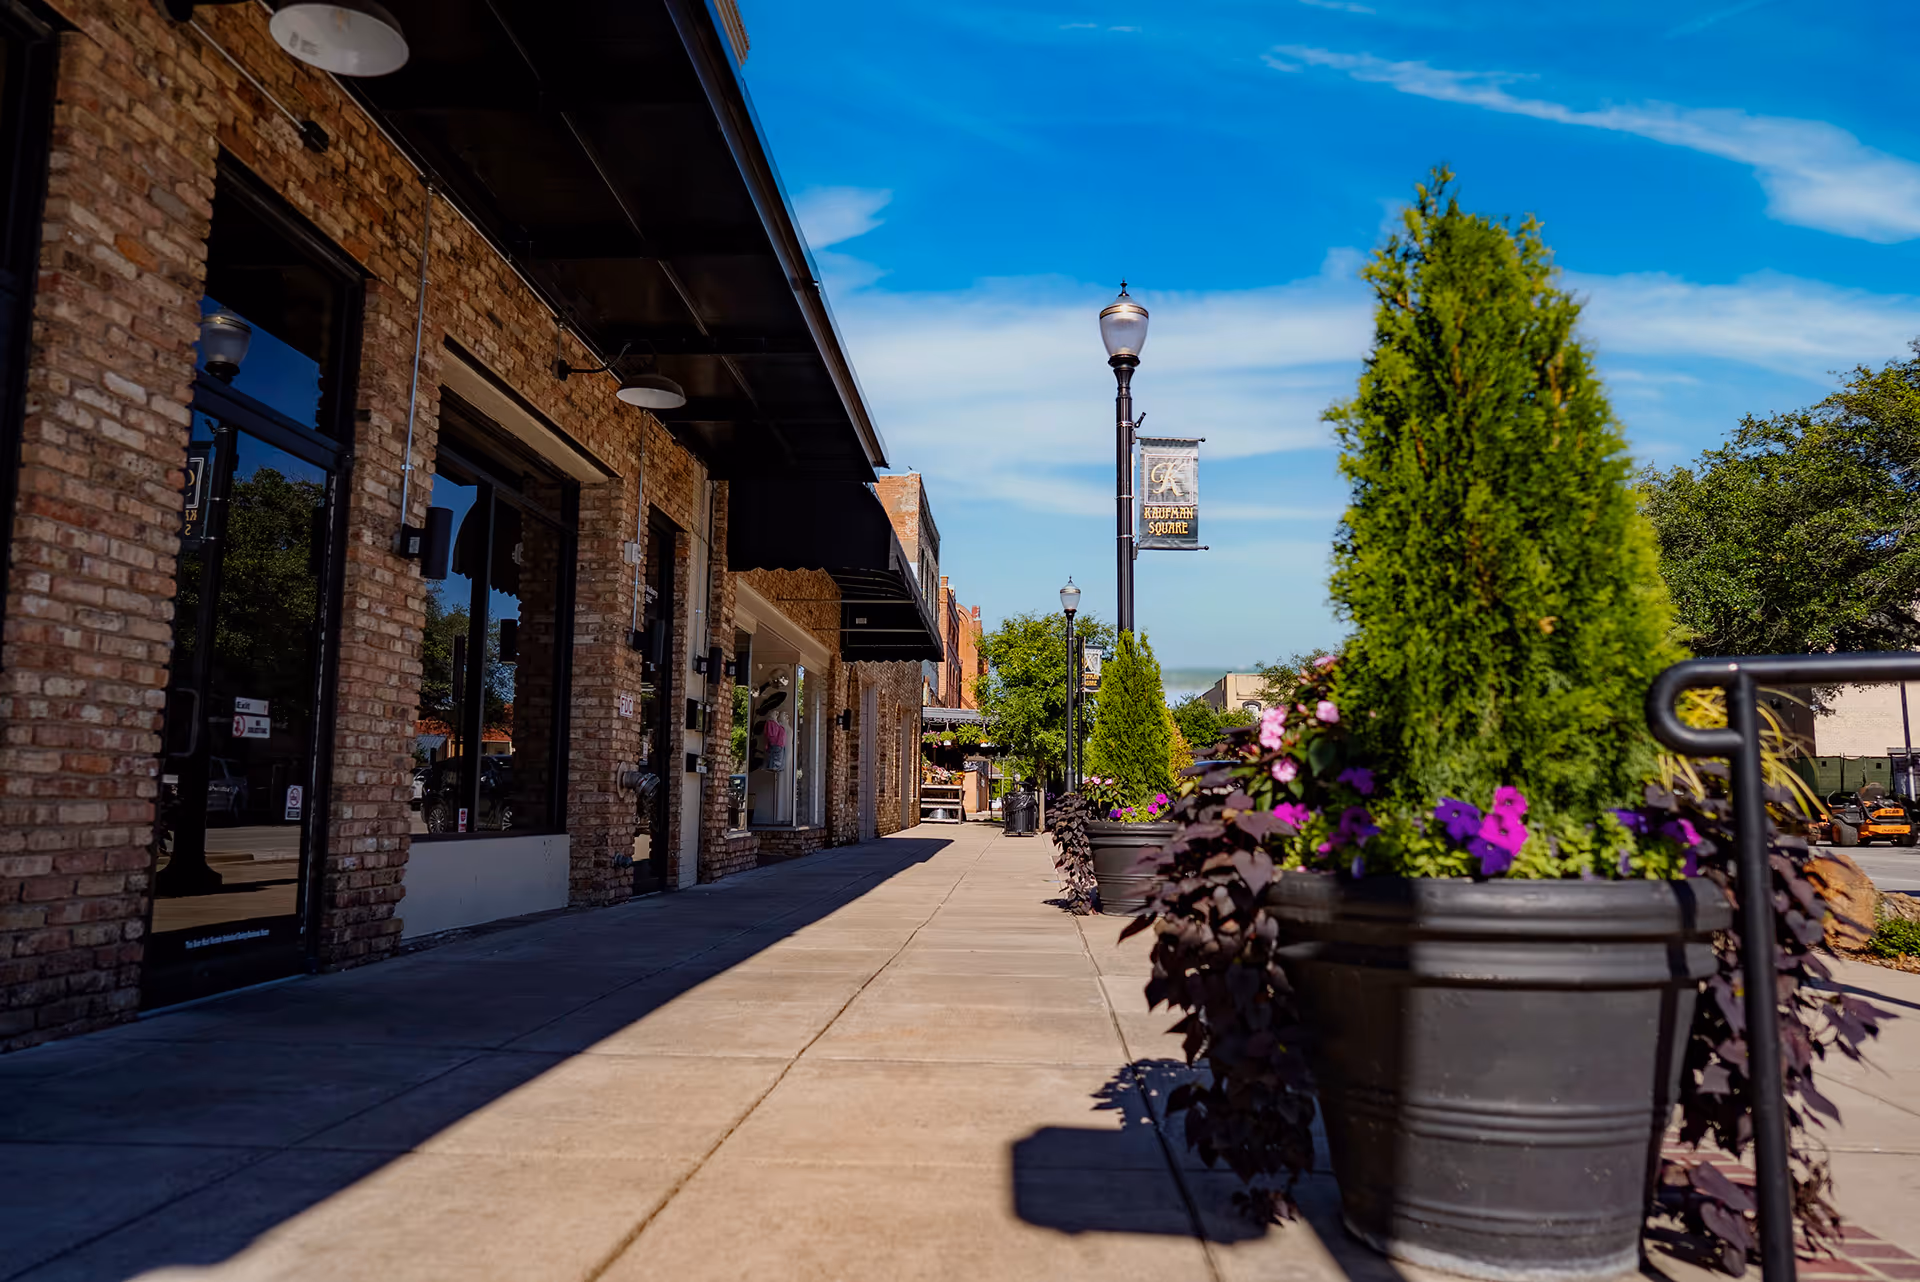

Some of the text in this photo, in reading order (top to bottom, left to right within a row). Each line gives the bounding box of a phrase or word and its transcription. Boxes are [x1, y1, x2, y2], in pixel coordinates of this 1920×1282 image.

[1151, 460, 1187, 497] K
[1144, 507, 1193, 519] KAUFMAN
[1148, 521, 1188, 536] SQUARE
